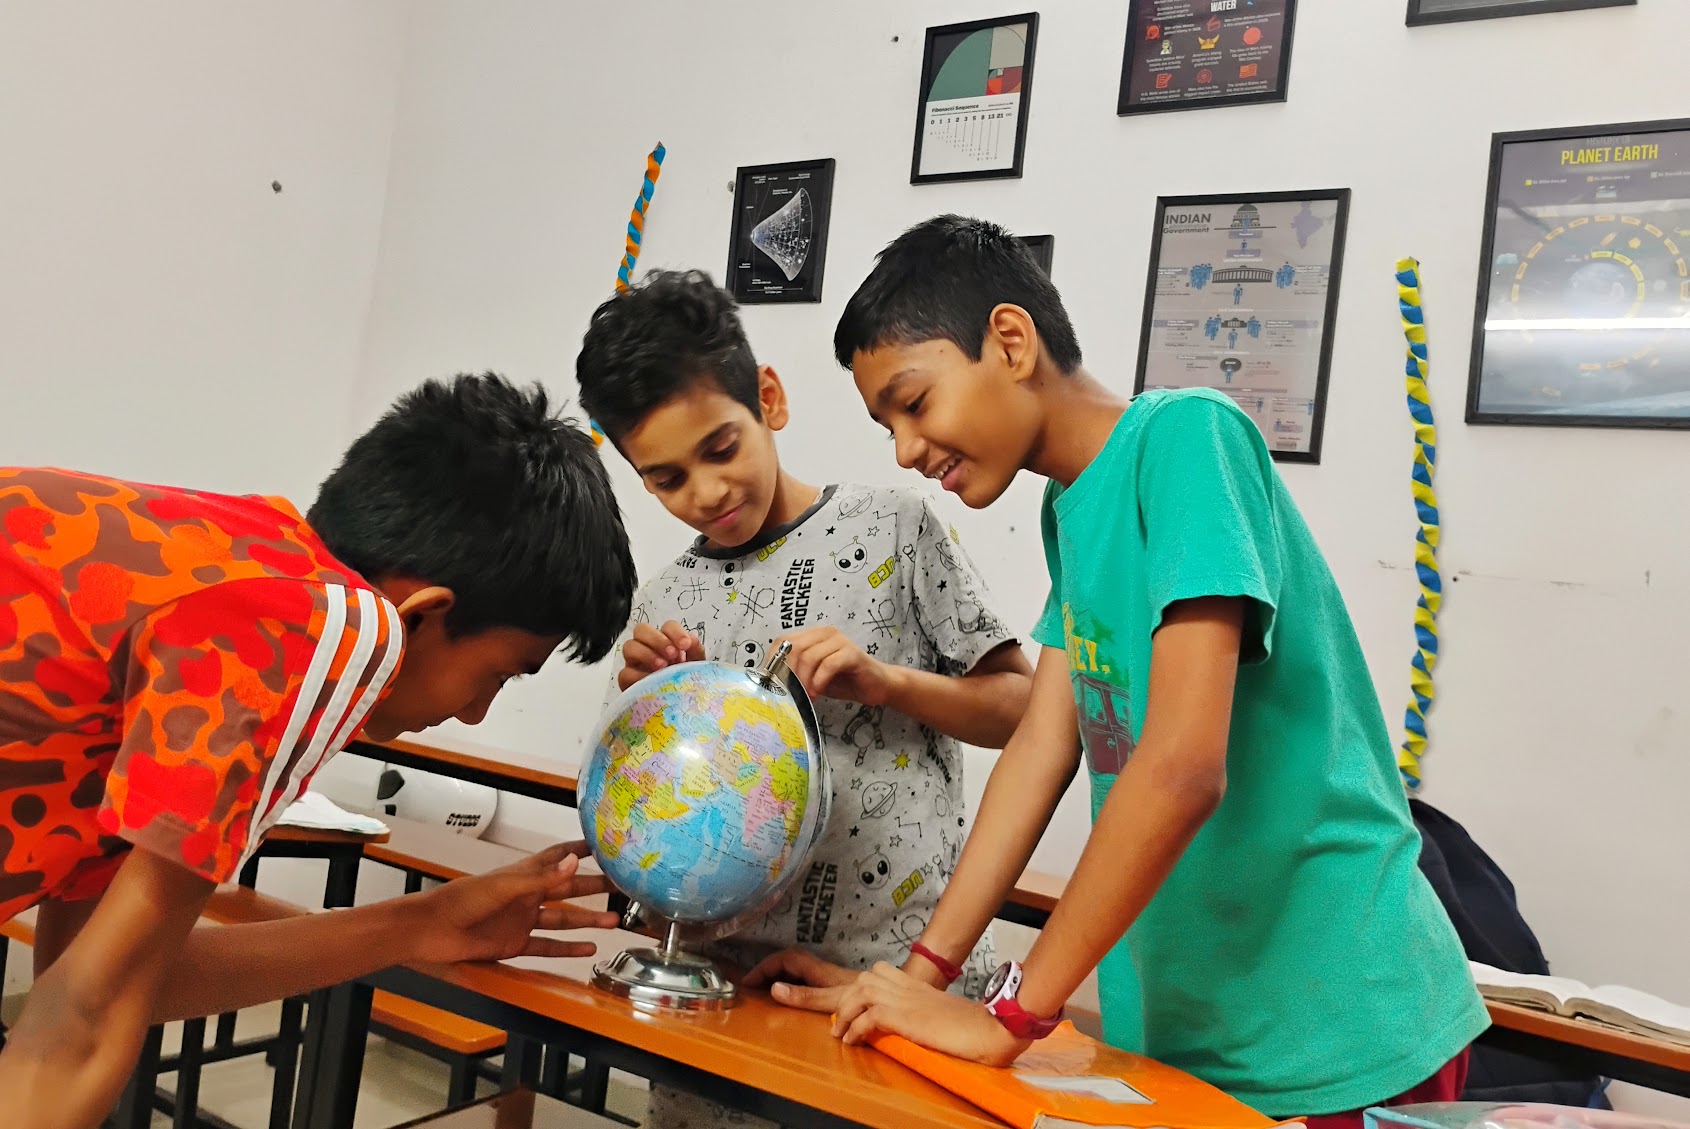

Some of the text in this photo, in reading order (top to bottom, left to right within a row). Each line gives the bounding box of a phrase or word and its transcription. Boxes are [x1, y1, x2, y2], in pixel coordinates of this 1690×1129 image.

[1210, 0, 1237, 13] WATER
[1561, 144, 1659, 166] PLANET EARTH
[1165, 213, 1212, 225] INDIAN
[1163, 227, 1210, 235] Government
[781, 559, 804, 629] FANTASTIC
[794, 559, 815, 627] ROCKETER
